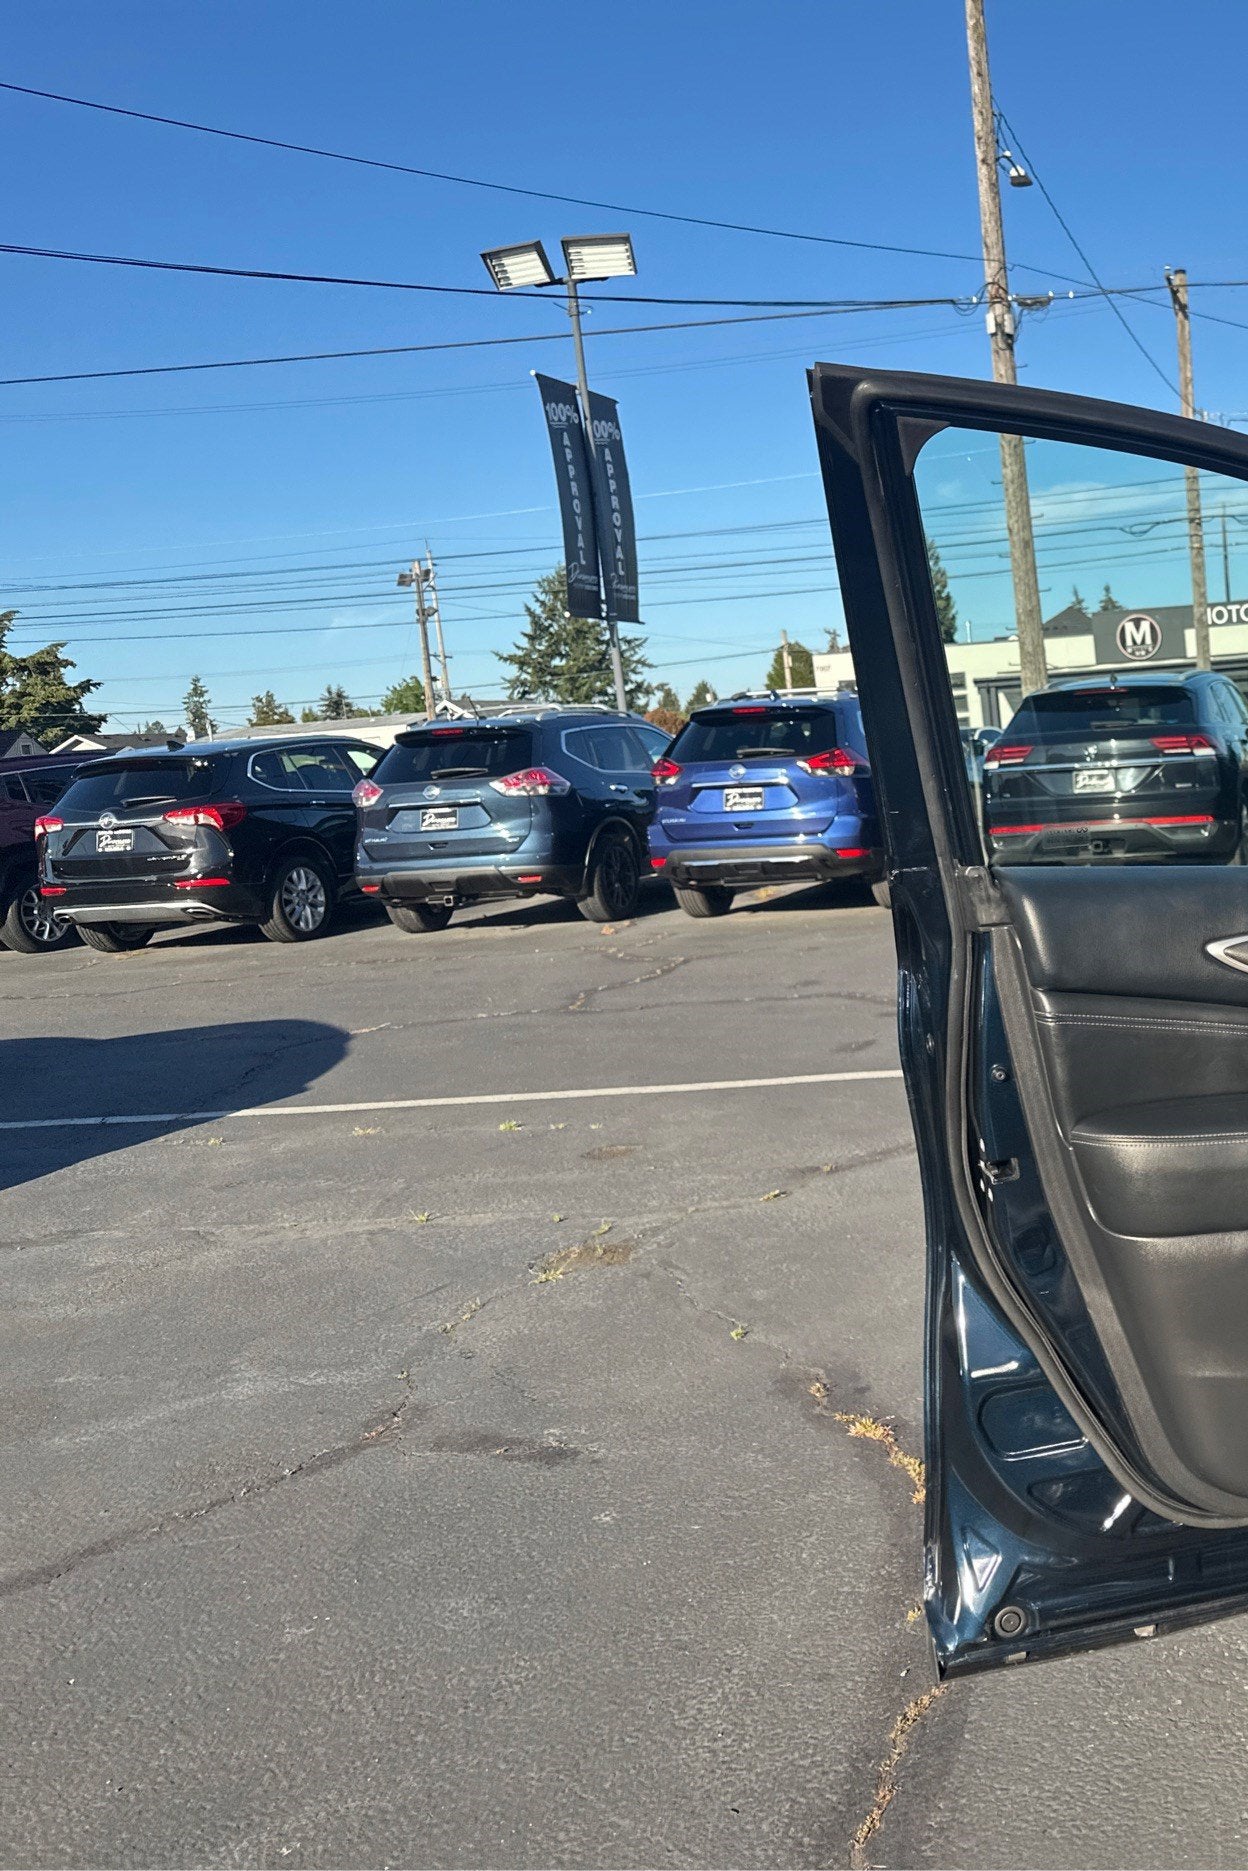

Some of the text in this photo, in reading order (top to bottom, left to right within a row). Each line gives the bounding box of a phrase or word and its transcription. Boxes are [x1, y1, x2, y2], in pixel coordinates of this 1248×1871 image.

[545, 402, 580, 424] 100%
[592, 420, 621, 441] 00%
[562, 431, 586, 565] APPROVAL
[604, 448, 625, 576] APPROVAL
[1124, 620, 1152, 646] M
